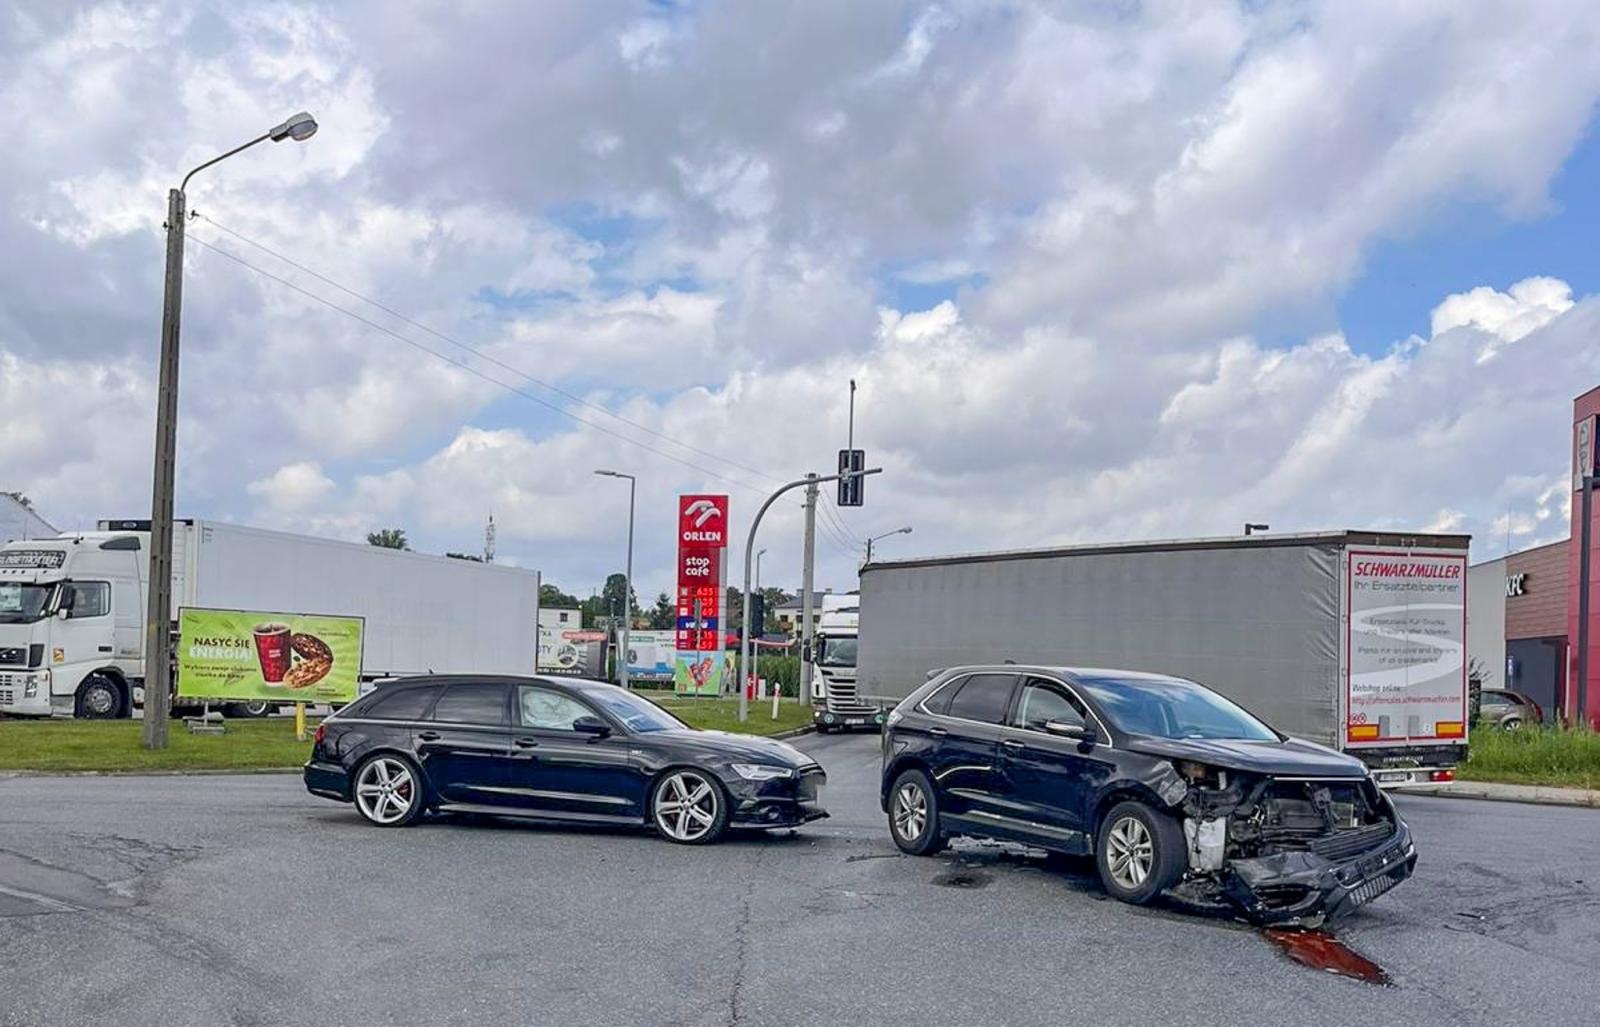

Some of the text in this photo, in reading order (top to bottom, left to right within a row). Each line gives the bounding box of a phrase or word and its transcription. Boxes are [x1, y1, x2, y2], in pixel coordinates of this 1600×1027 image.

[683, 531, 721, 541] ORLEN
[686, 556, 710, 567] stop
[685, 566, 710, 577] cafe
[1355, 562, 1460, 579] SCHWARZMÜLLER
[1504, 573, 1524, 597] KFC
[194, 636, 250, 648] NASYĆ SIĘ
